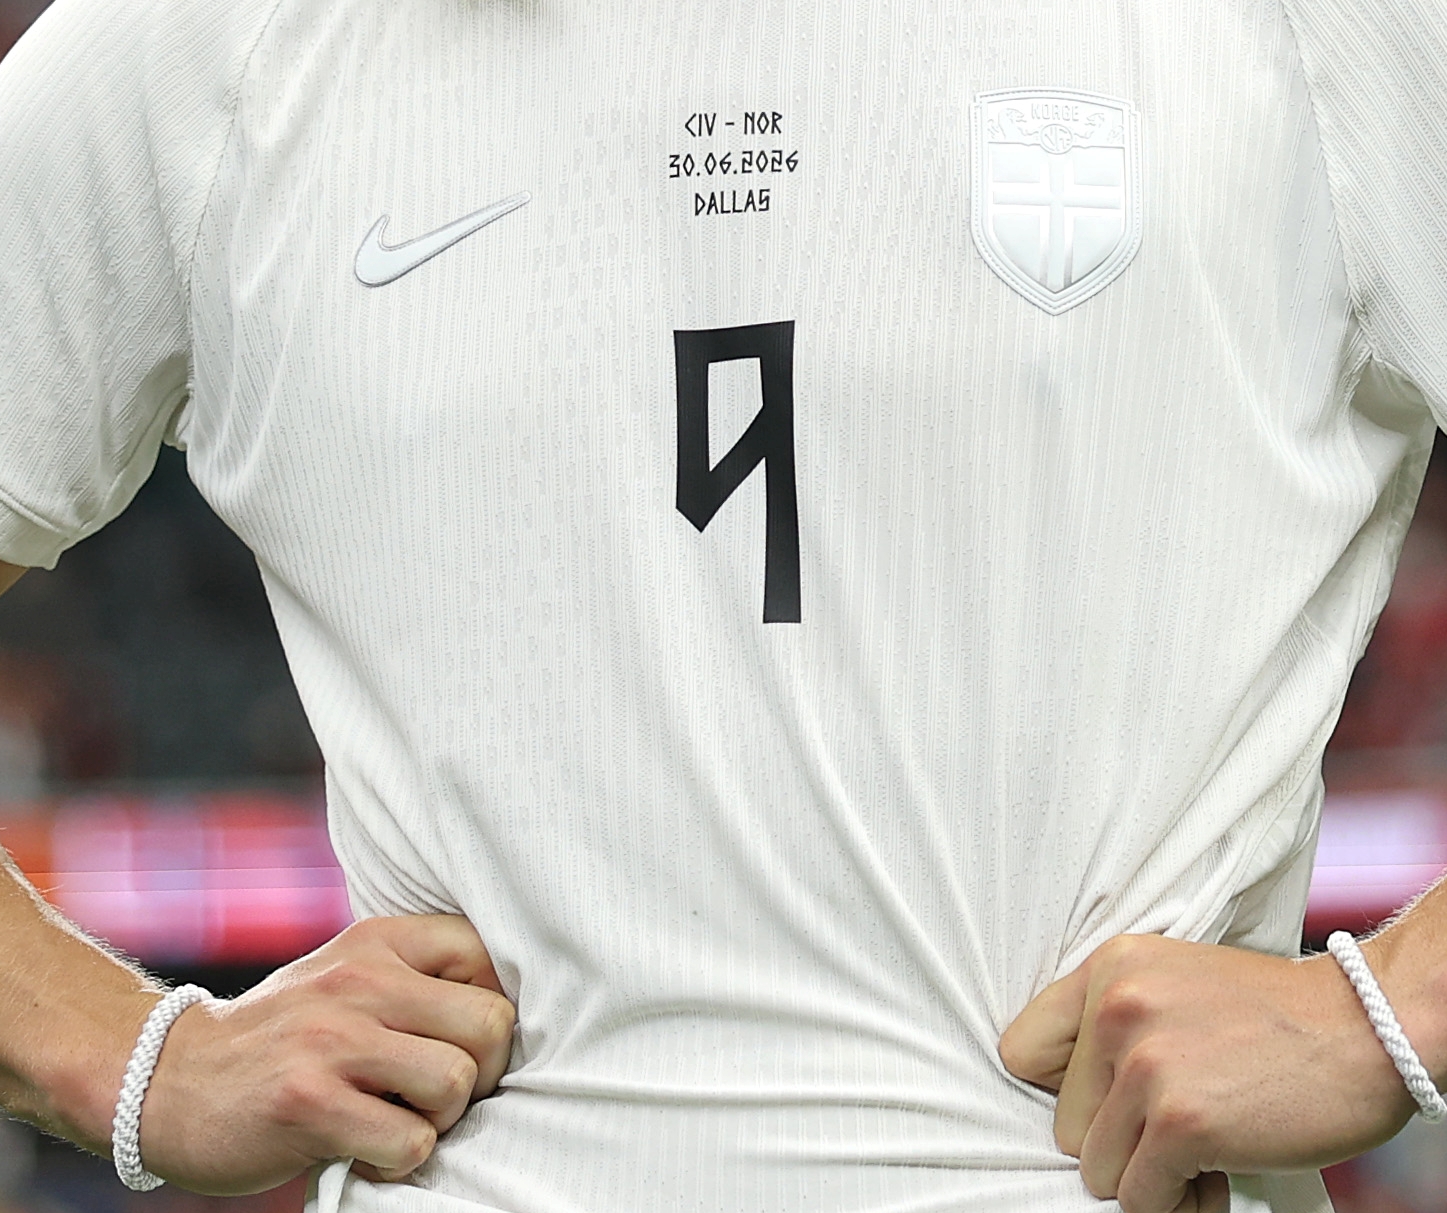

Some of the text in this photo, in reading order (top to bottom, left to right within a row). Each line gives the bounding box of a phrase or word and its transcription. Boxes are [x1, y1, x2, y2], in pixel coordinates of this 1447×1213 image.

[685, 112, 717, 137] CIV
[744, 111, 783, 135] NOR
[1031, 102, 1080, 122] NORGE
[669, 149, 799, 178] 30.06.2026
[695, 188, 771, 216] DALLAS
[673, 320, 801, 623] 9
